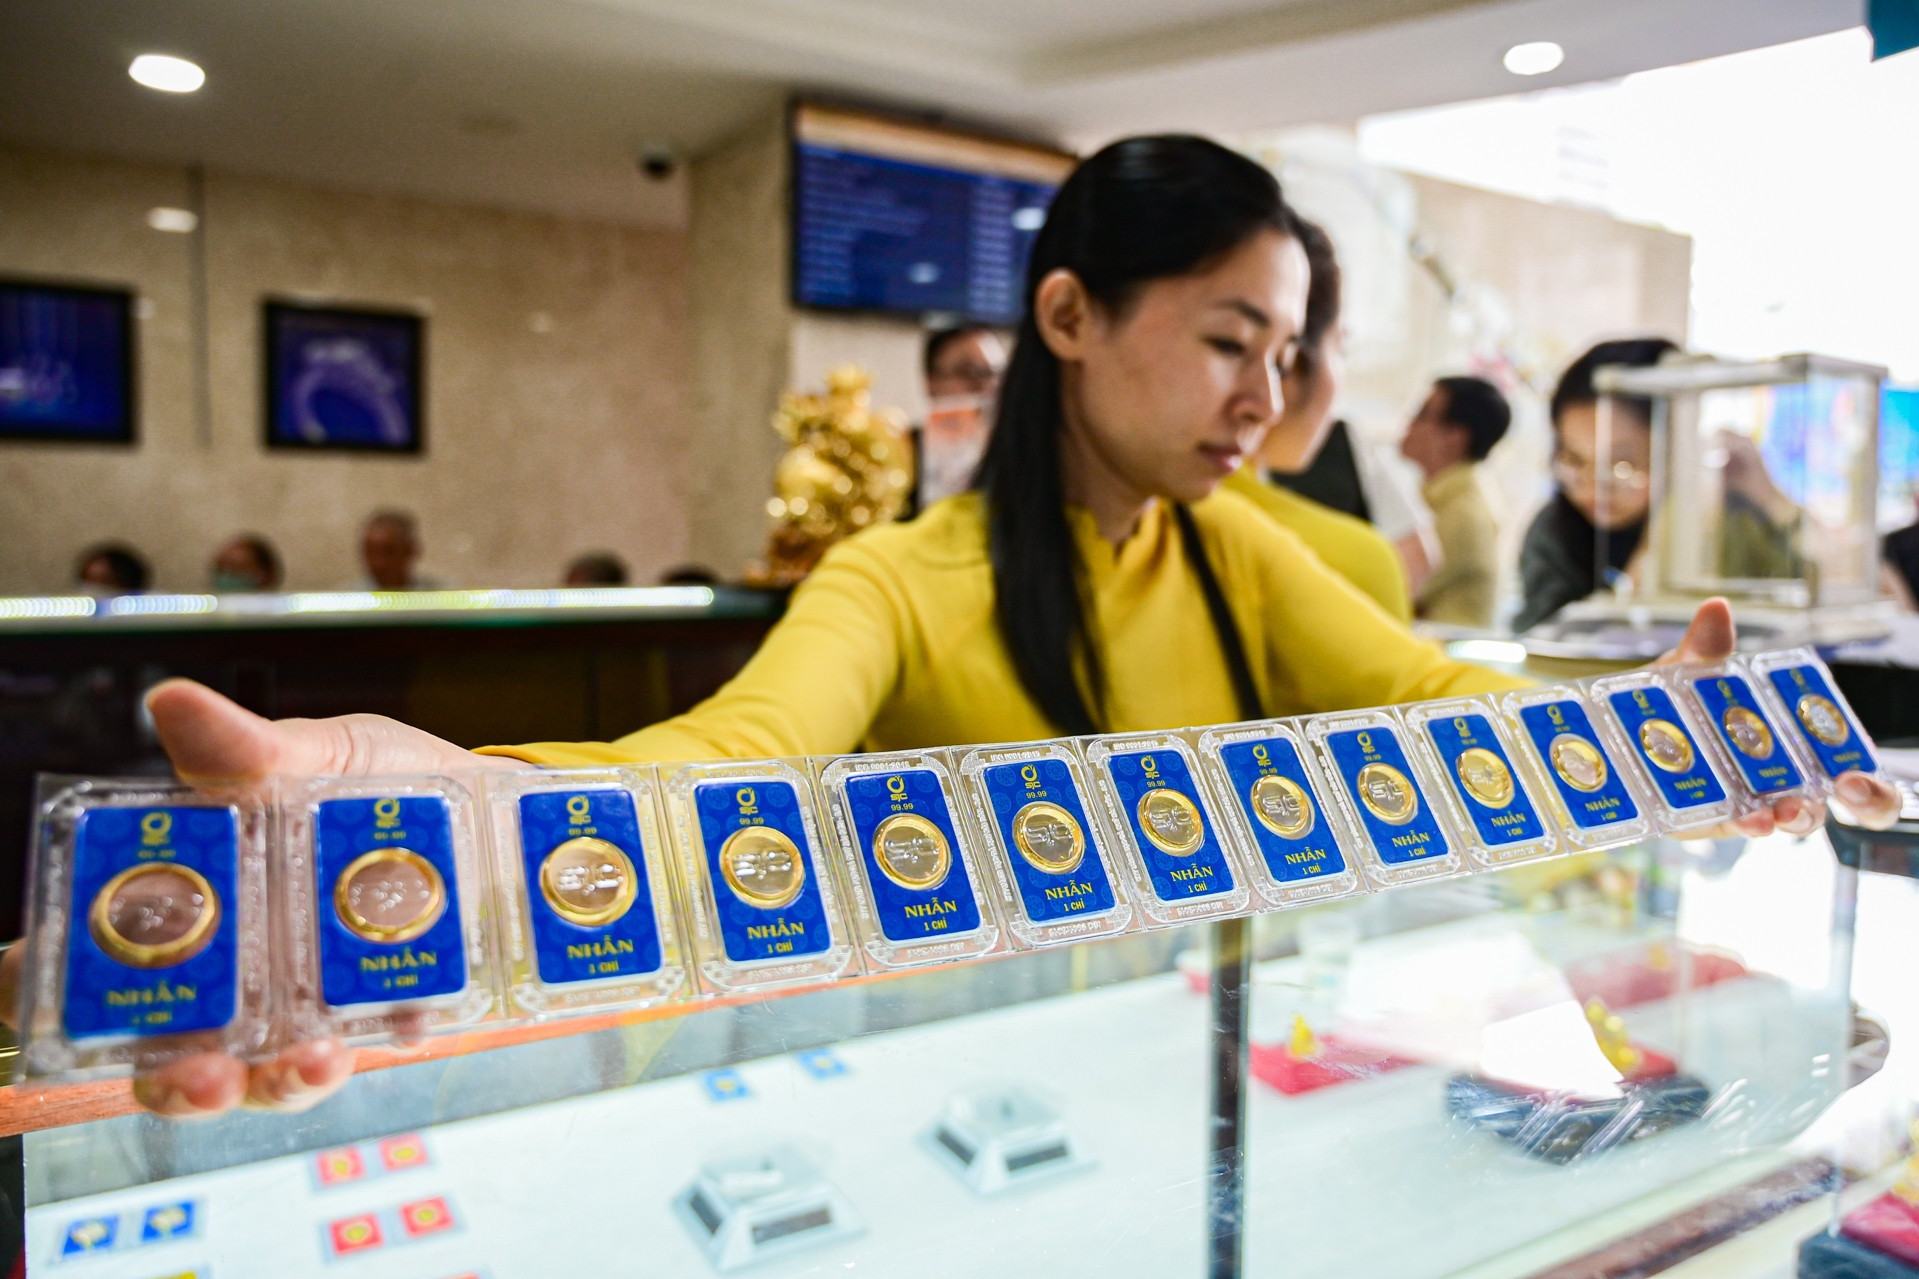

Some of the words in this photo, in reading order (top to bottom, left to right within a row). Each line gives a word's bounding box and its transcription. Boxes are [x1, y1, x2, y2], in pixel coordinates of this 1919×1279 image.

[1147, 780, 1166, 788] 99.99
[1026, 791, 1047, 799] 99.99
[891, 803, 914, 811] 99.99
[739, 817, 764, 825] 99.99
[1392, 830, 1430, 847] NHẪN
[1285, 846, 1326, 864] NHẪN
[1170, 863, 1214, 881] NHẪN
[1303, 867, 1308, 875] 1
[1045, 880, 1093, 900] NHẪN
[1188, 885, 1194, 893] 1
[904, 897, 957, 918] NHẪN
[1064, 904, 1070, 912] 1
[747, 917, 804, 939] NHẪN
[924, 922, 930, 931] 1
[567, 935, 633, 958] NHẪN
[767, 944, 774, 954] 1
